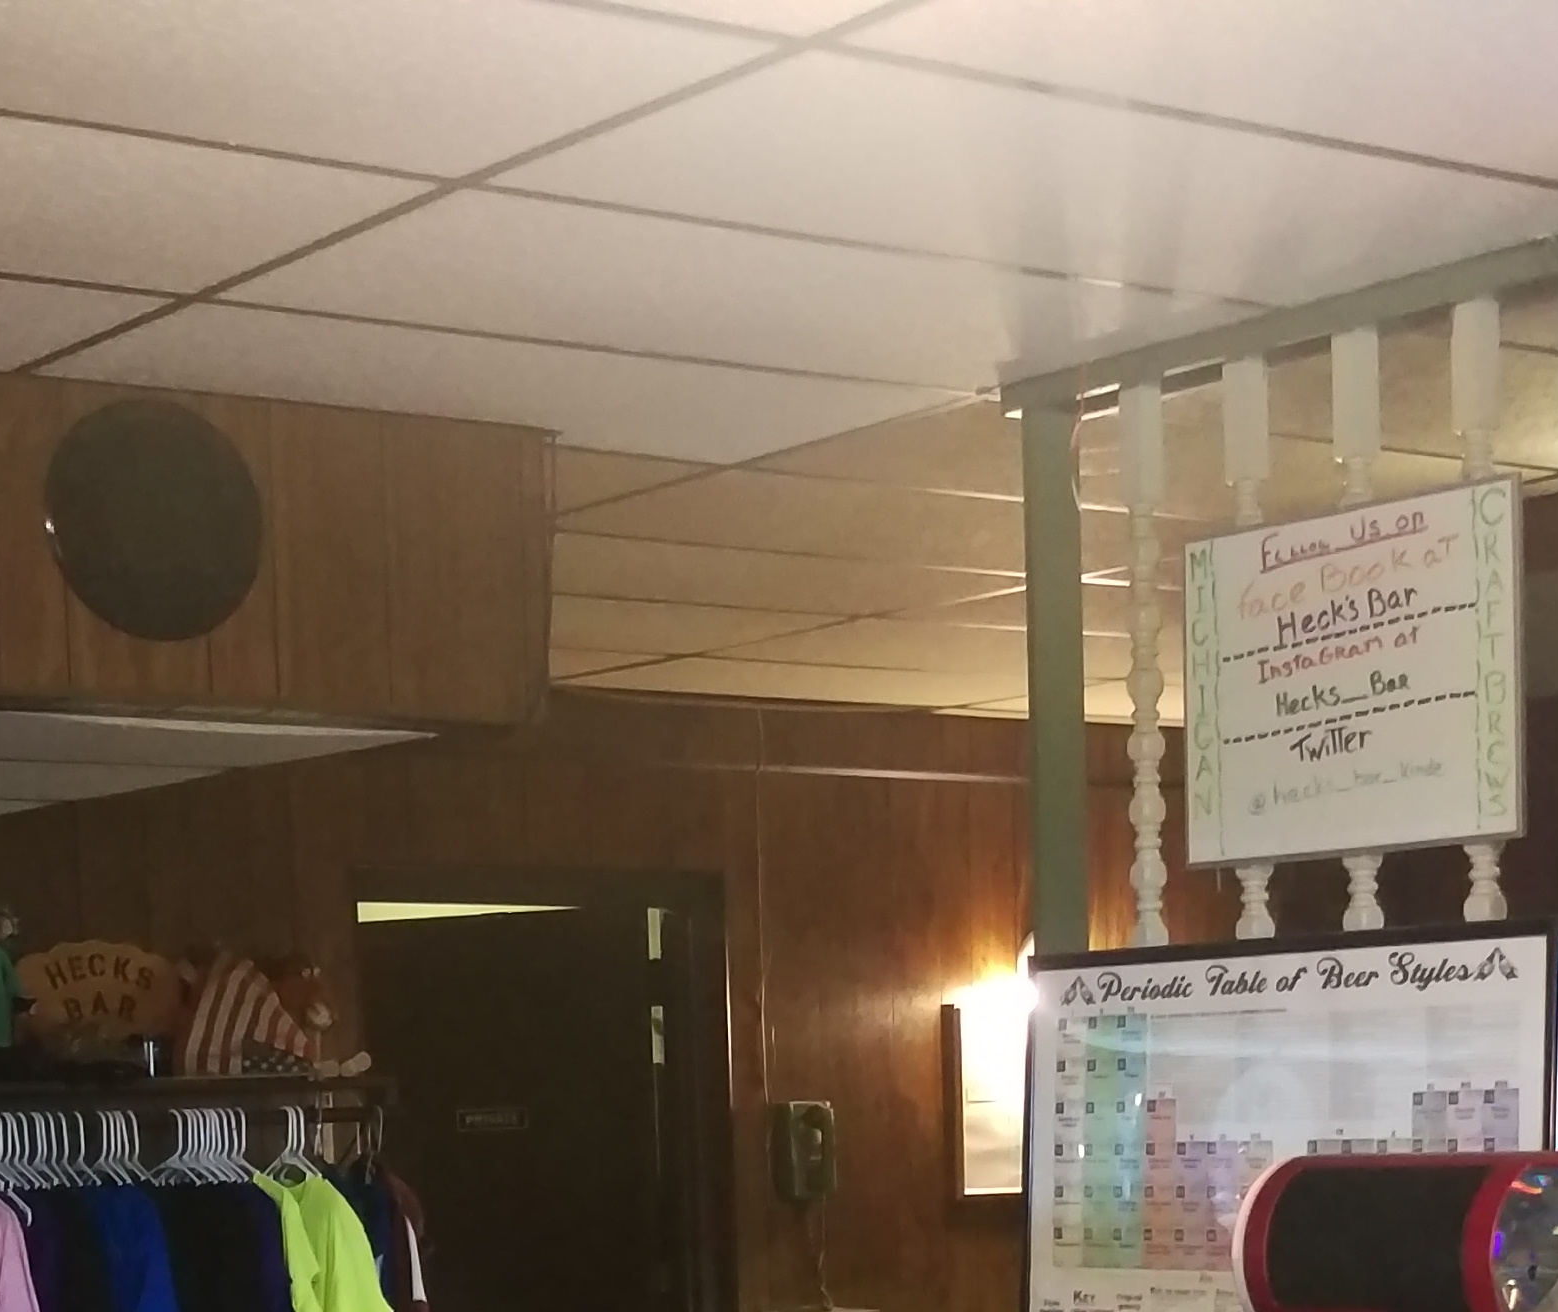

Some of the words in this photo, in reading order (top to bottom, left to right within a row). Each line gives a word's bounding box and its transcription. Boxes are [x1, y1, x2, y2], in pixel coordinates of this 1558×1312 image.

[1478, 488, 1507, 660] CRAFT
[1277, 594, 1359, 646] Heck's
[1368, 586, 1419, 618] Bar
[44, 953, 155, 990] HECKS
[1097, 971, 1194, 1003] Periodic
[1205, 963, 1269, 997] Table
[1275, 965, 1308, 993] of
[1316, 956, 1380, 990] Beer
[1388, 951, 1474, 992] Styles
[62, 990, 138, 1023] BAR
